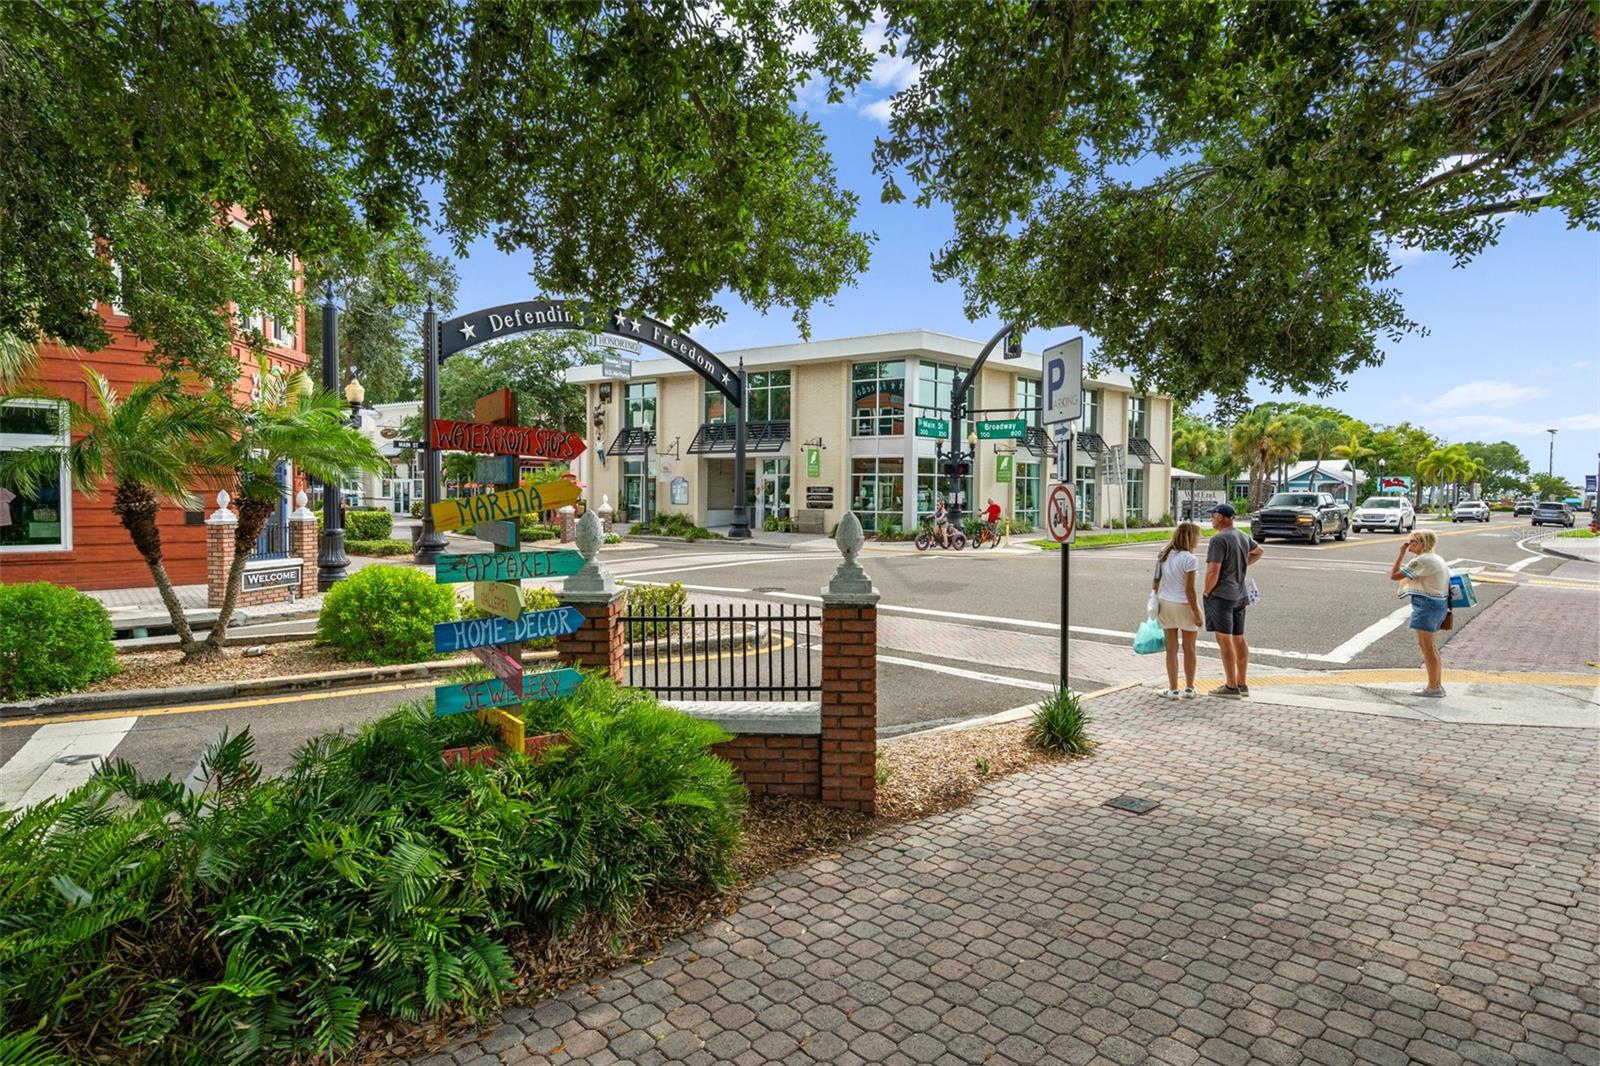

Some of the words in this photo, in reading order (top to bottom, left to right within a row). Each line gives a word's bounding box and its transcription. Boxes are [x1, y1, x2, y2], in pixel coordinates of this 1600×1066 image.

[488, 304, 584, 332] Defending
[653, 325, 715, 374] Freedom
[433, 420, 531, 454] WATERFRONT
[535, 430, 575, 457] SHOPS
[924, 420, 936, 429] Main
[938, 422, 944, 430] St
[983, 422, 1017, 431] Broadway
[247, 571, 297, 584] WELCOME
[464, 552, 558, 581] APPAREL
[453, 617, 506, 650] HOME
[514, 609, 573, 641] DECOR
